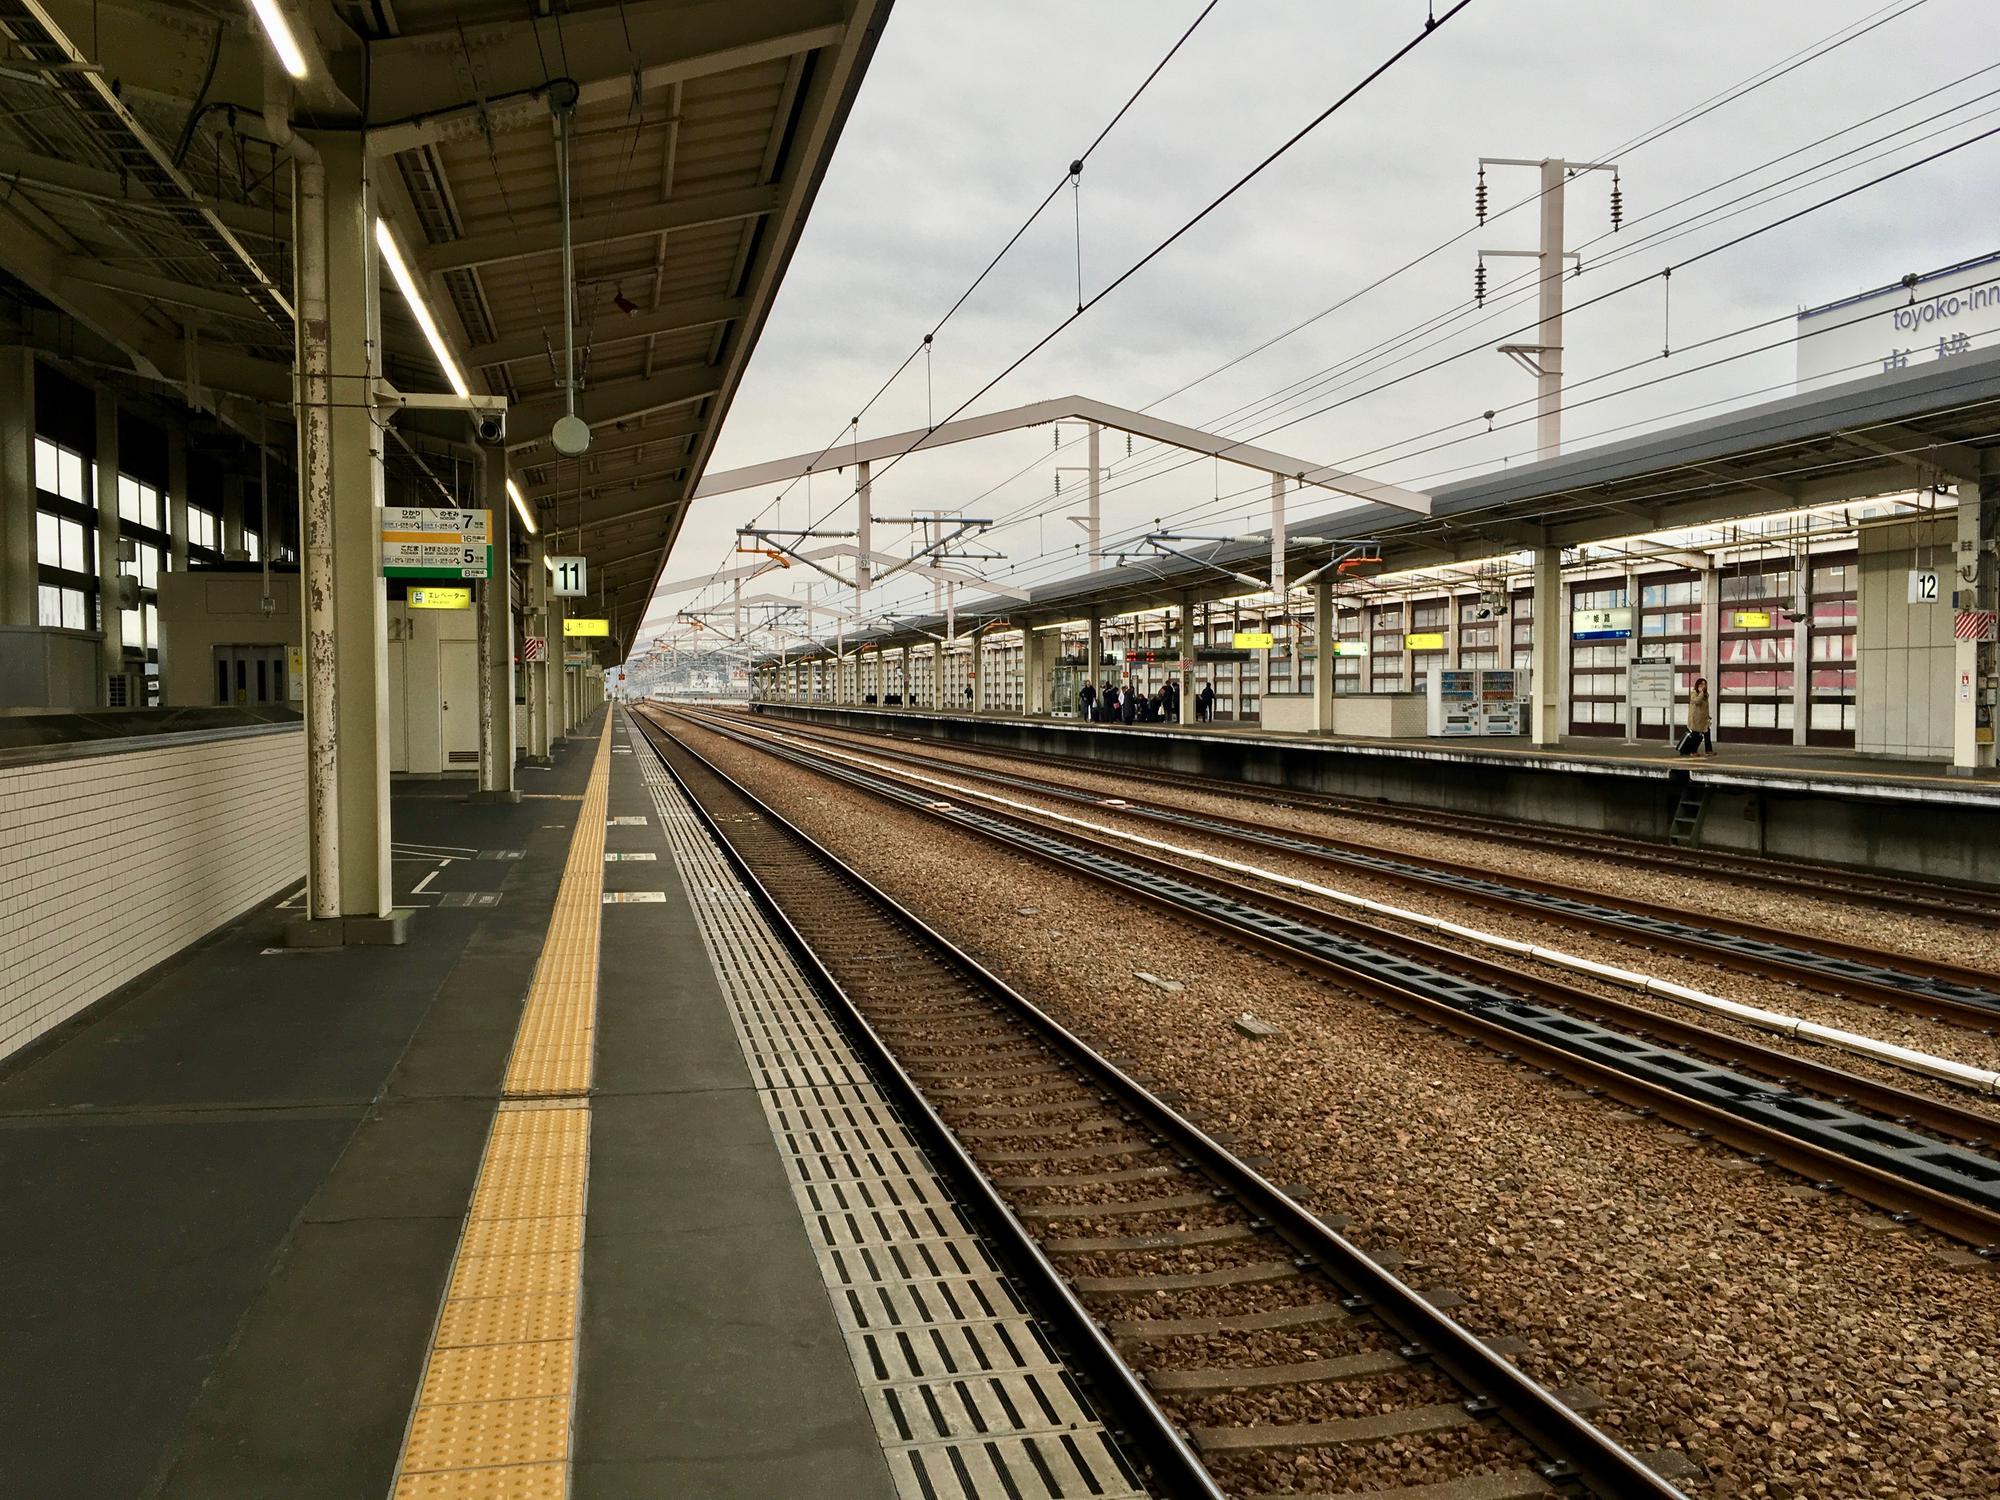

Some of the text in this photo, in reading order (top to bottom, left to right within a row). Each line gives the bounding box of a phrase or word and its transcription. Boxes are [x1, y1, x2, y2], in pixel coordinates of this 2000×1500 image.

[1893, 284, 2000, 332] toyoko-inn
[462, 515, 473, 529] 7
[463, 549, 474, 563] 5
[559, 563, 579, 590] 11
[1919, 575, 1936, 599] 12
